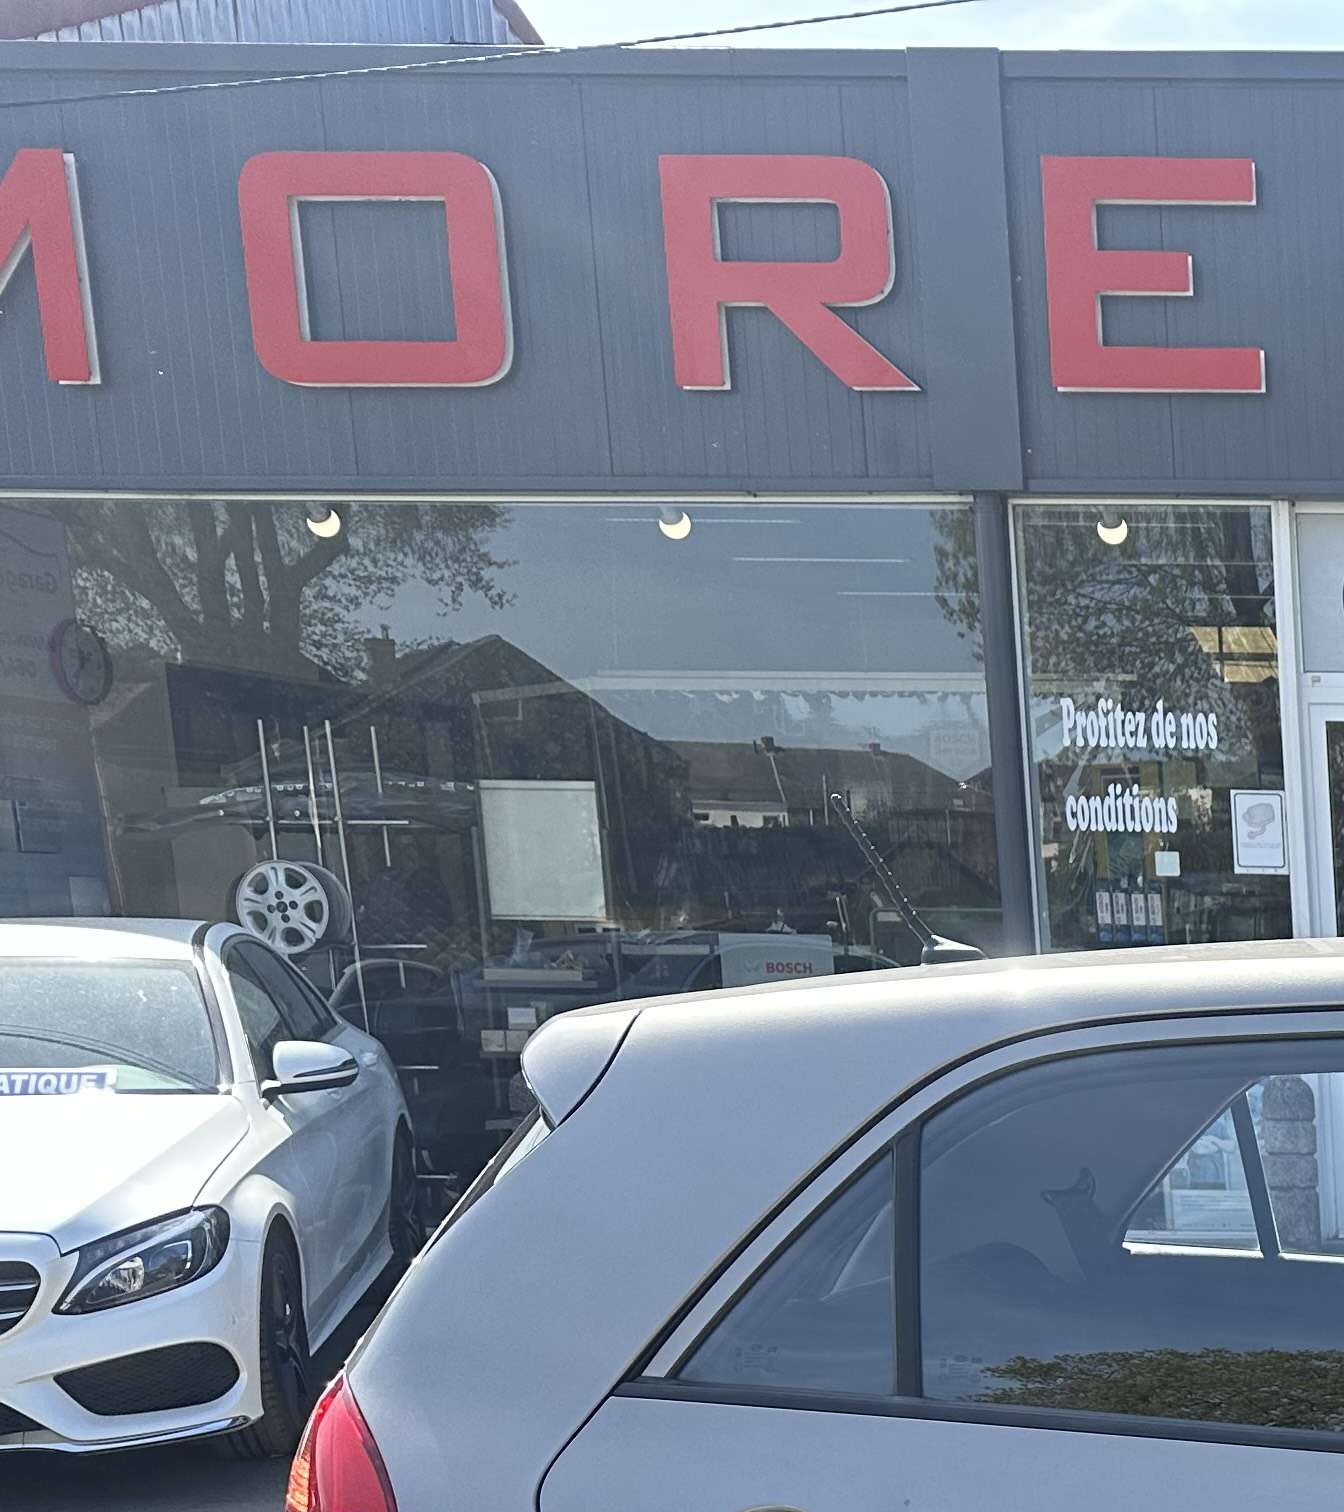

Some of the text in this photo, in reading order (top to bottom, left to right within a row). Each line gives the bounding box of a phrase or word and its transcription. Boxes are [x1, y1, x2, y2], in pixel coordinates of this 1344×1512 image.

[1060, 697, 1218, 749] Profitez de nos
[1065, 783, 1178, 833] conditions
[766, 960, 813, 975] BOSCH
